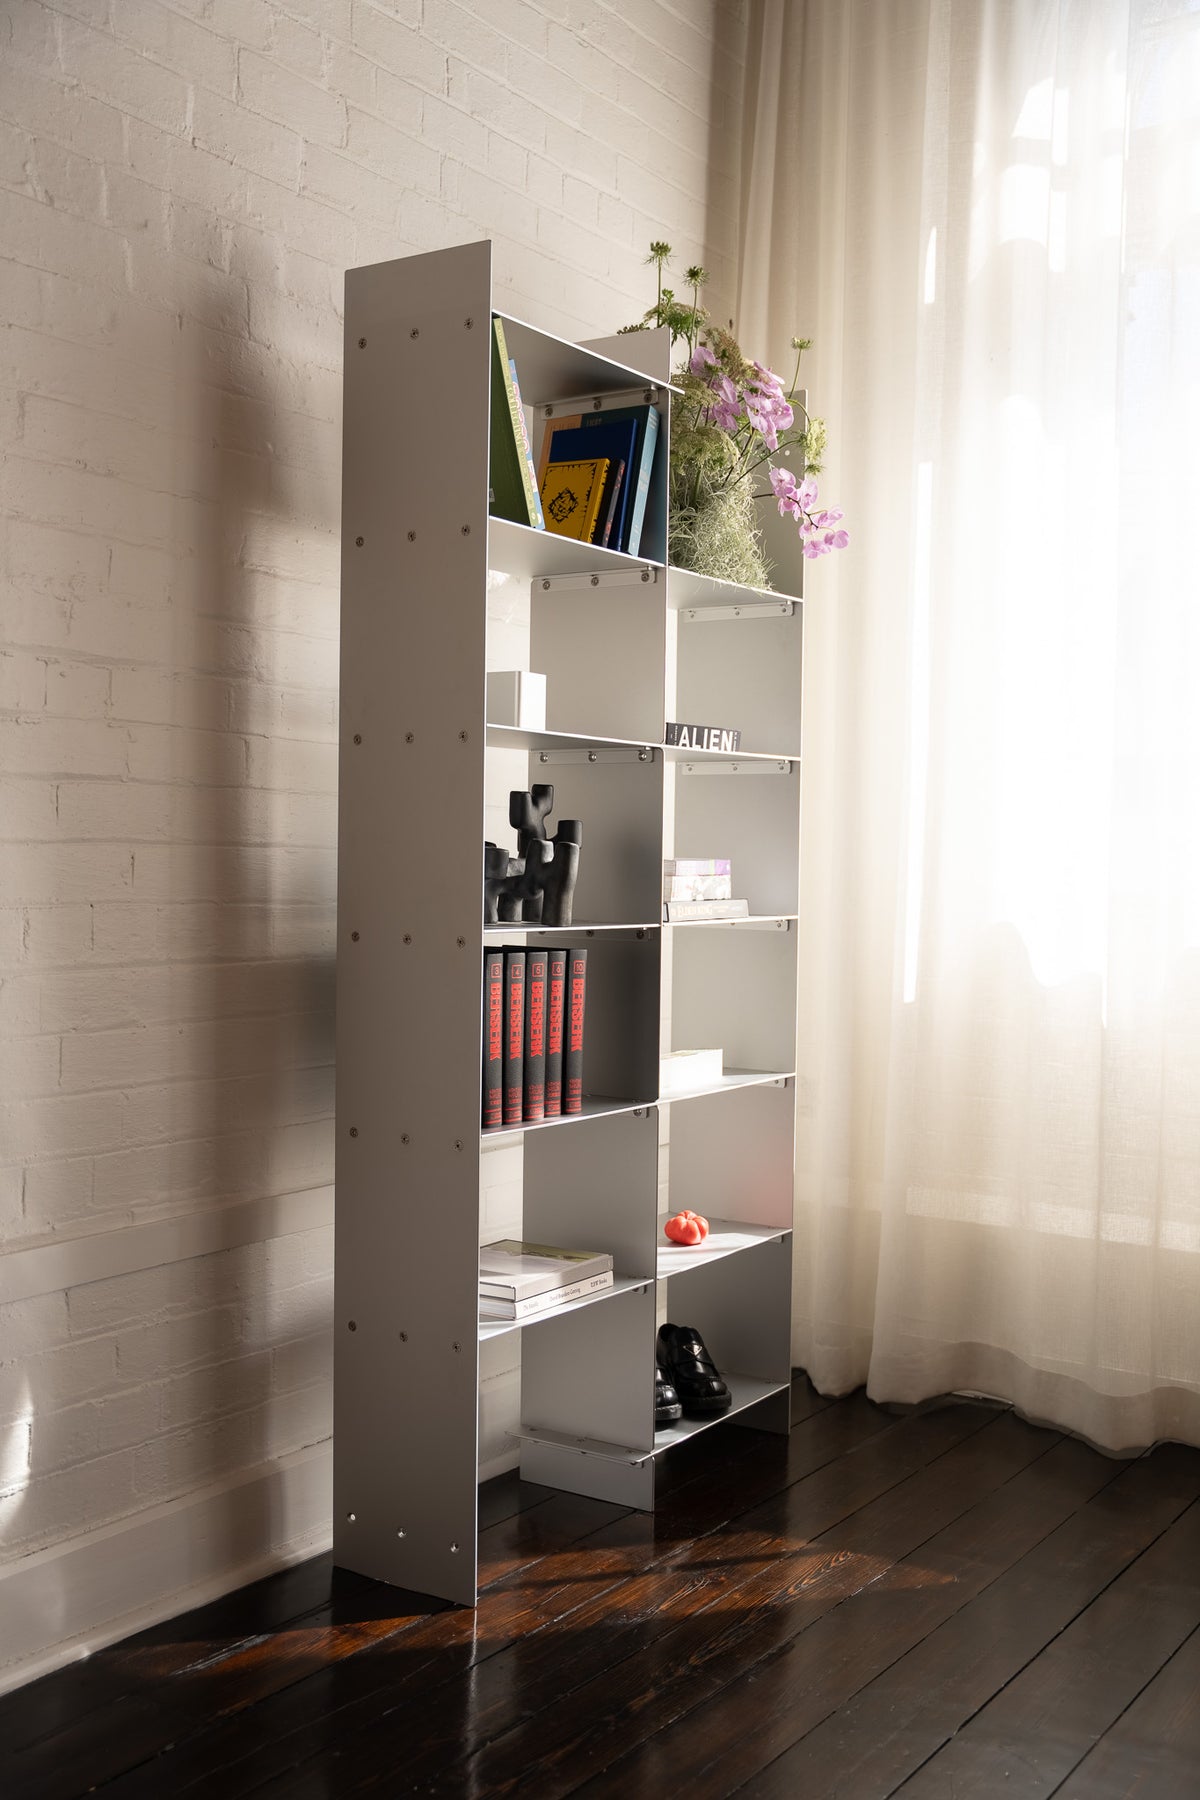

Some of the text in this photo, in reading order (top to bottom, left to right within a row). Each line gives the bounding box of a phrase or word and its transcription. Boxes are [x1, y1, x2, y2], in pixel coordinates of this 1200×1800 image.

[679, 726, 733, 752] ALIEN
[490, 982, 501, 1061] BERSERK
[510, 983, 523, 1060] BERSERK
[531, 981, 544, 1057] BERSERK
[549, 980, 563, 1054] BERSERK
[571, 978, 584, 1052] BERSERK
